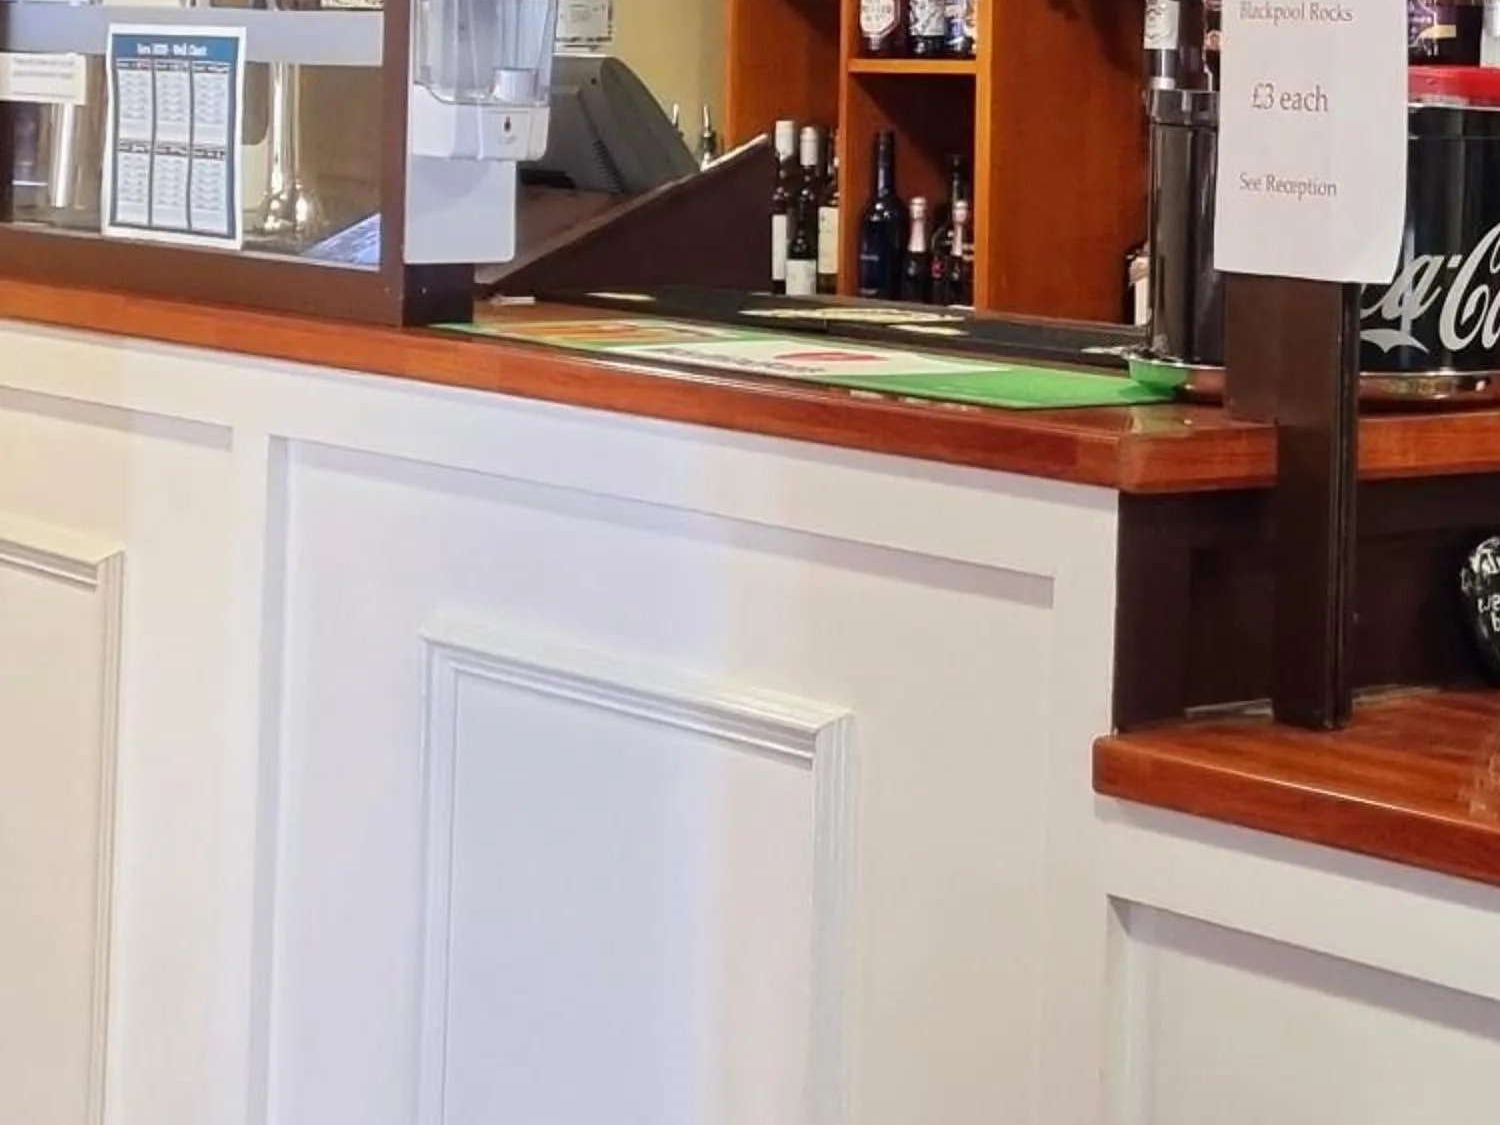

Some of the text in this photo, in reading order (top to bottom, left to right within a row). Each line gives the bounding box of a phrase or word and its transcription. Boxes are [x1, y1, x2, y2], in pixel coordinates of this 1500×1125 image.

[1239, 0, 1354, 26] Blackpool Rocks
[1251, 82, 1330, 113] £3 each
[1239, 172, 1338, 202] See Reception
